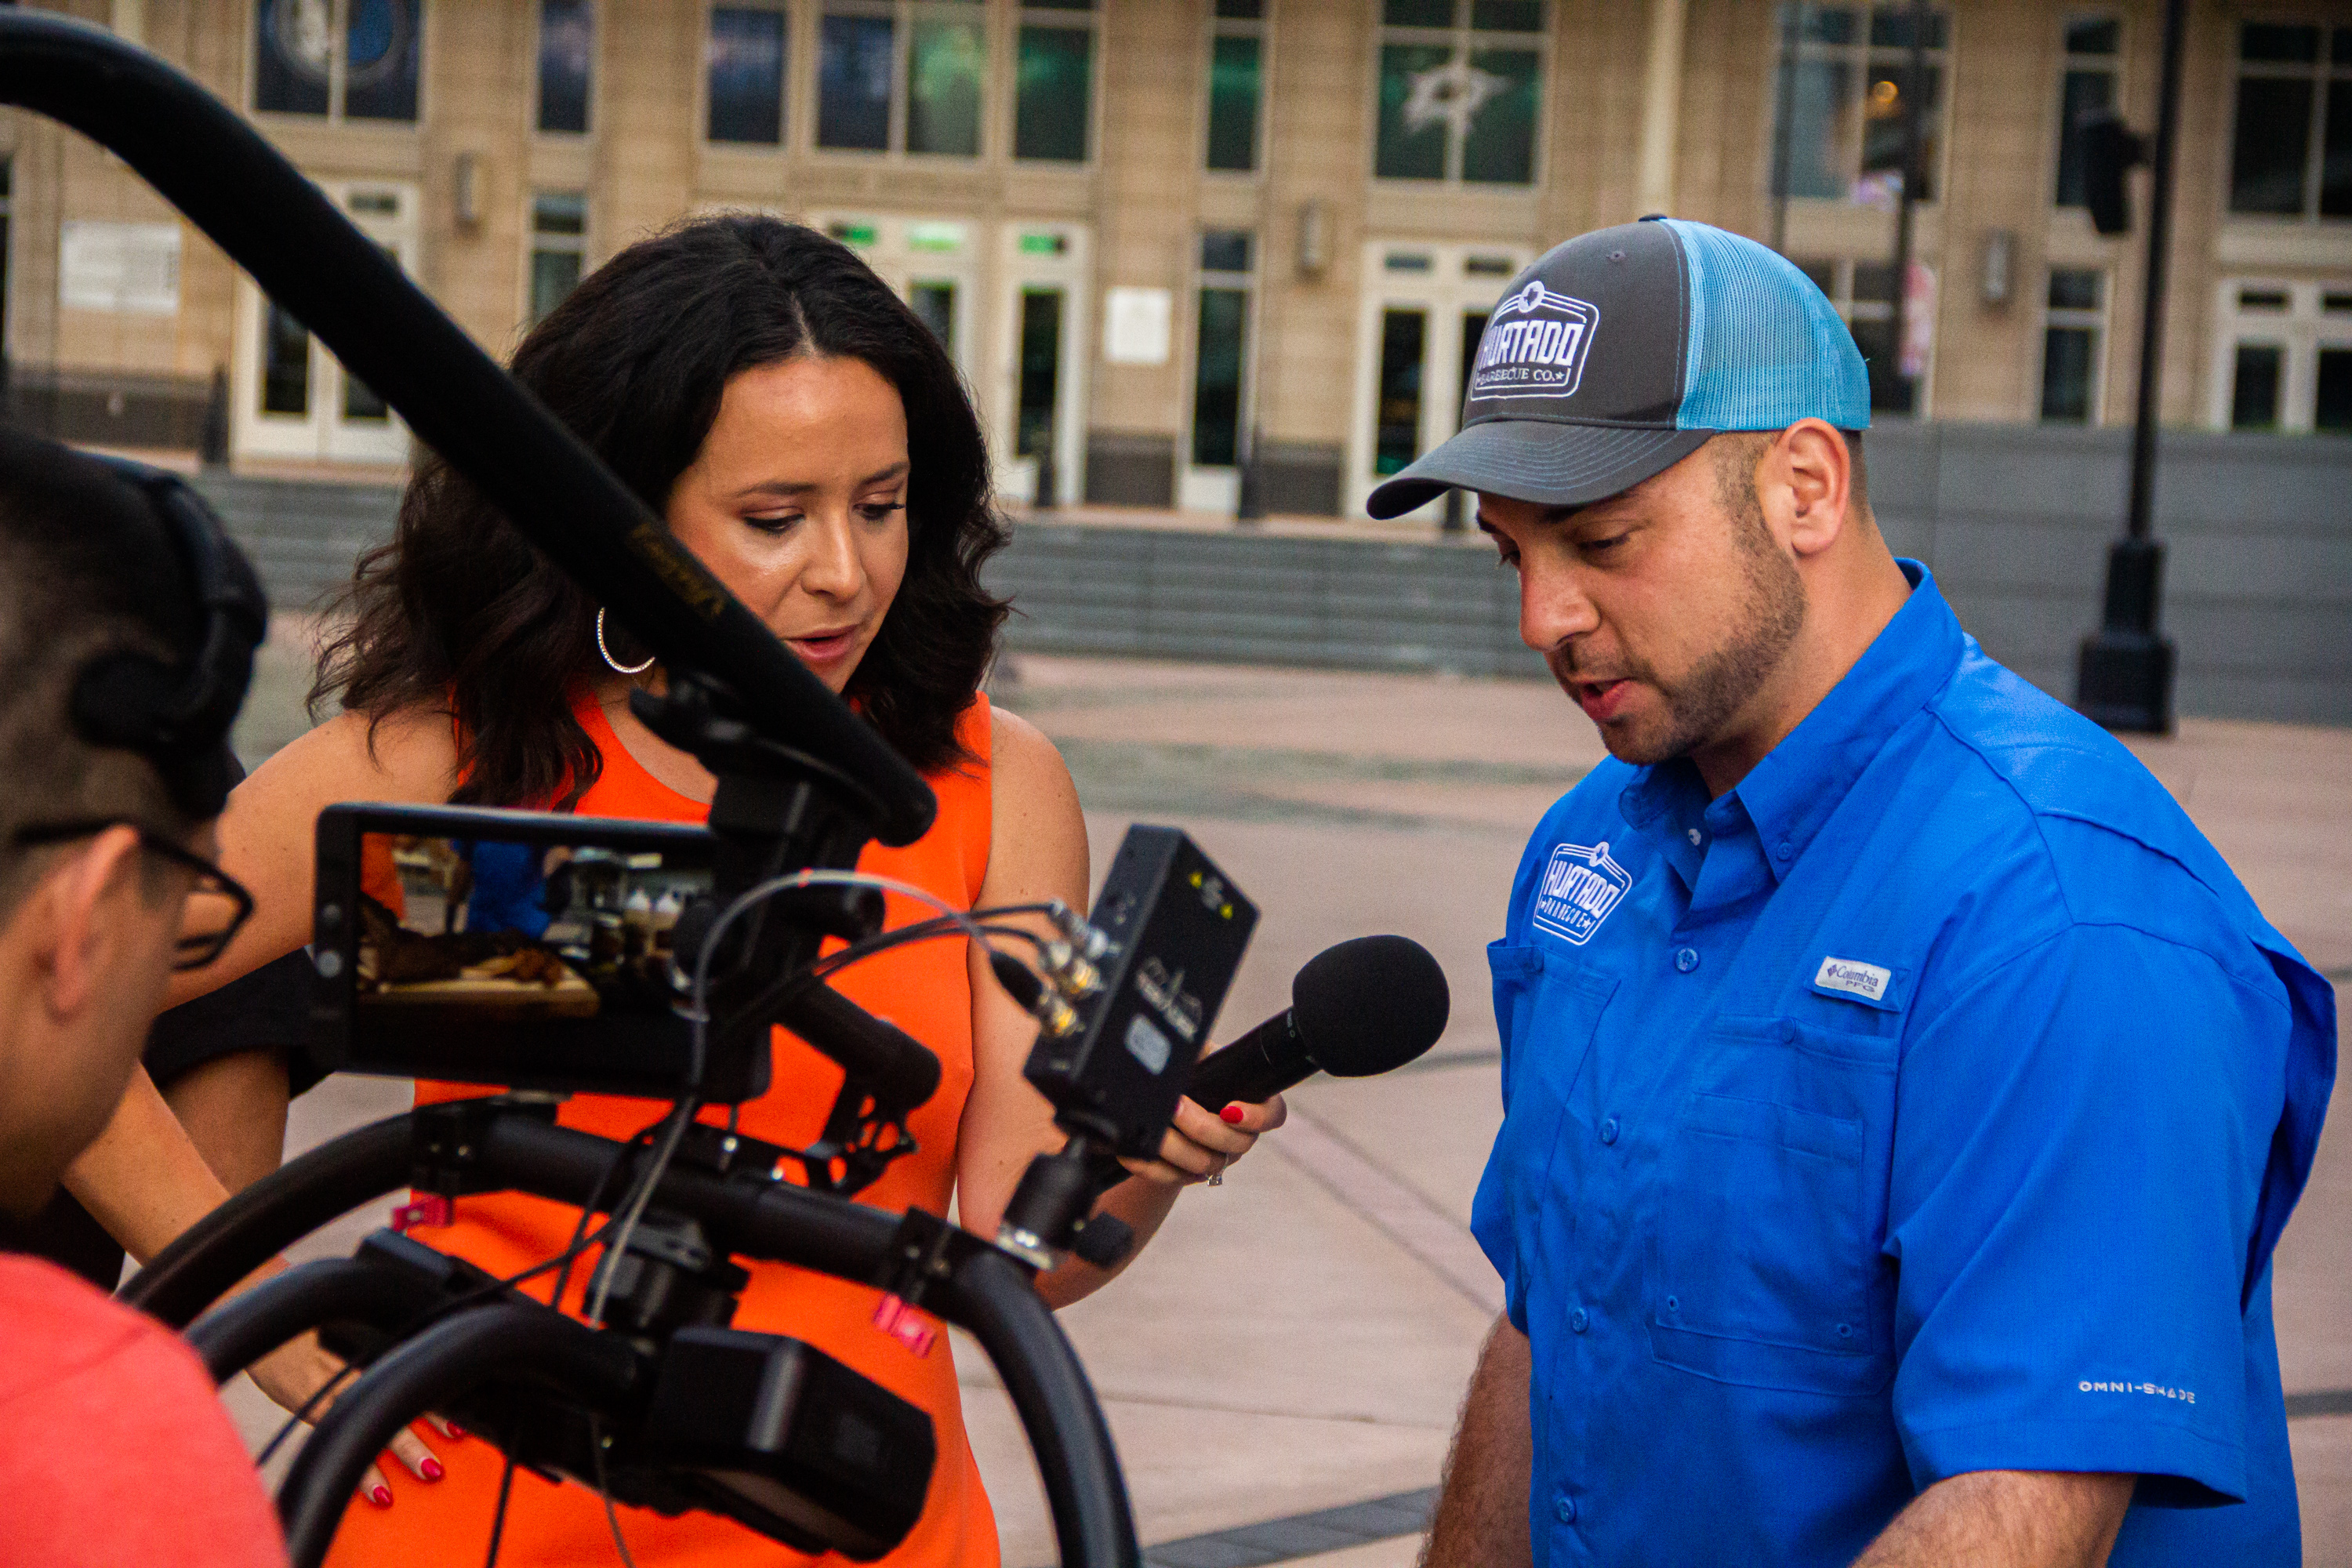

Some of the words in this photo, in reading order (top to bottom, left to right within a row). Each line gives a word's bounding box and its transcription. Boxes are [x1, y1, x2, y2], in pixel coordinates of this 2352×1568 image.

[1478, 320, 1586, 371] HURTADO
[1543, 859, 1621, 920] HURTADO
[1836, 965, 1879, 987] Columbia
[1846, 980, 1875, 993] PFG
[2078, 1381, 2195, 1404] OMNI-SHADE
